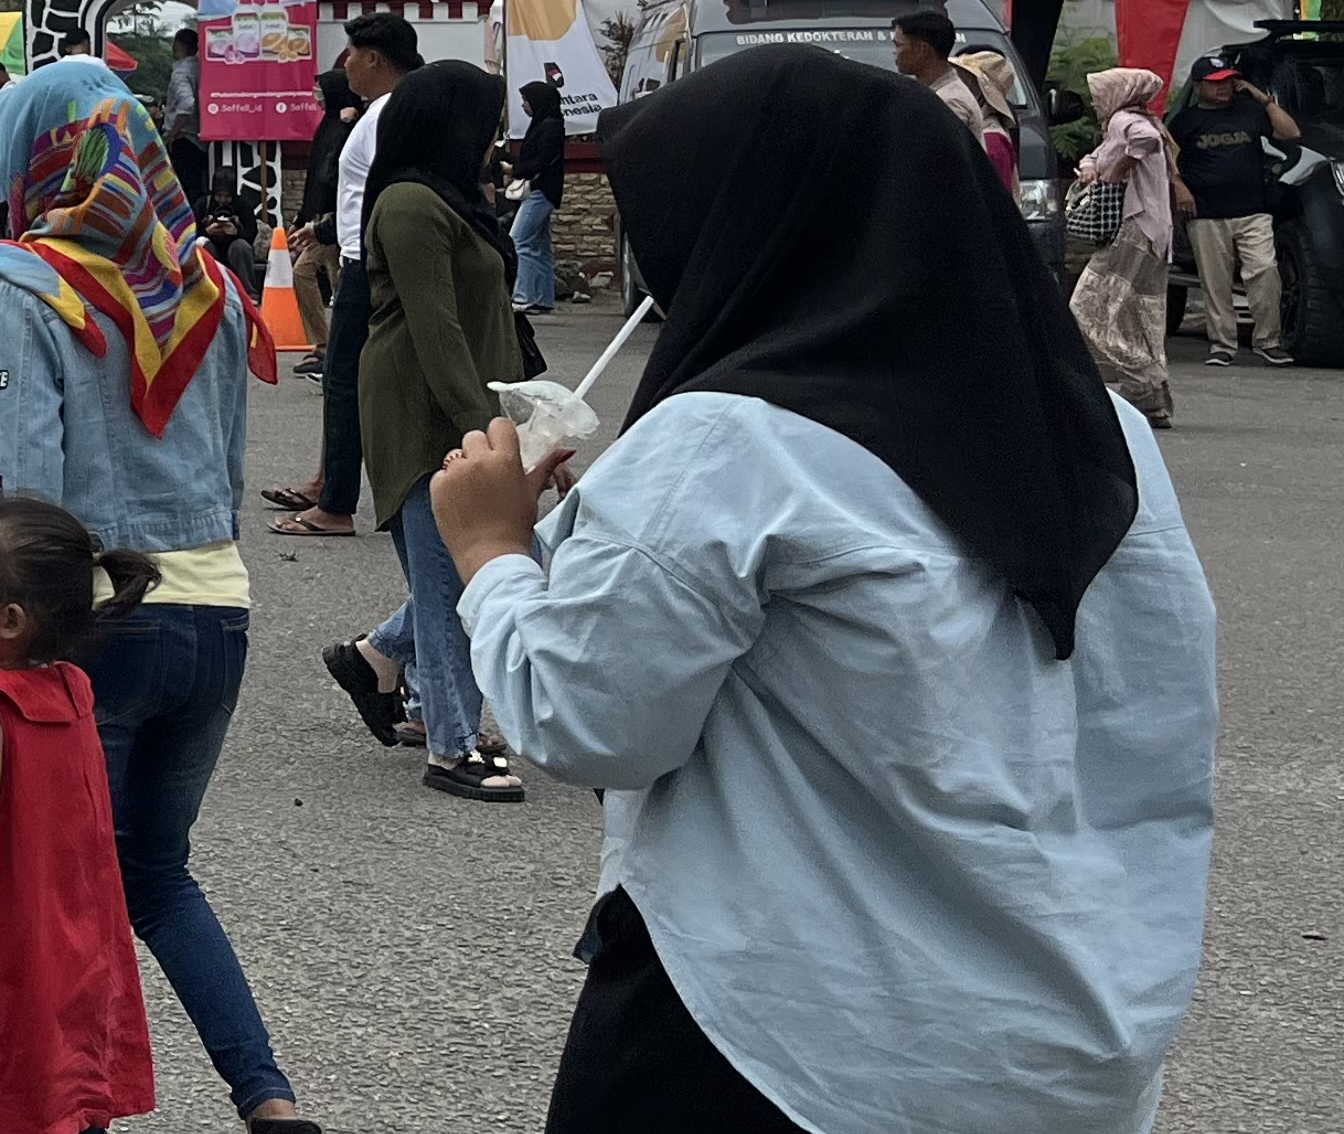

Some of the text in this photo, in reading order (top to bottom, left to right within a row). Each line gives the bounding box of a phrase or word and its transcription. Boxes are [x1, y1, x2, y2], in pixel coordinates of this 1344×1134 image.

[736, 32, 784, 46] BIDANG
[787, 31, 874, 43] KEDOKTERAN
[1197, 131, 1251, 149] JOGJA
